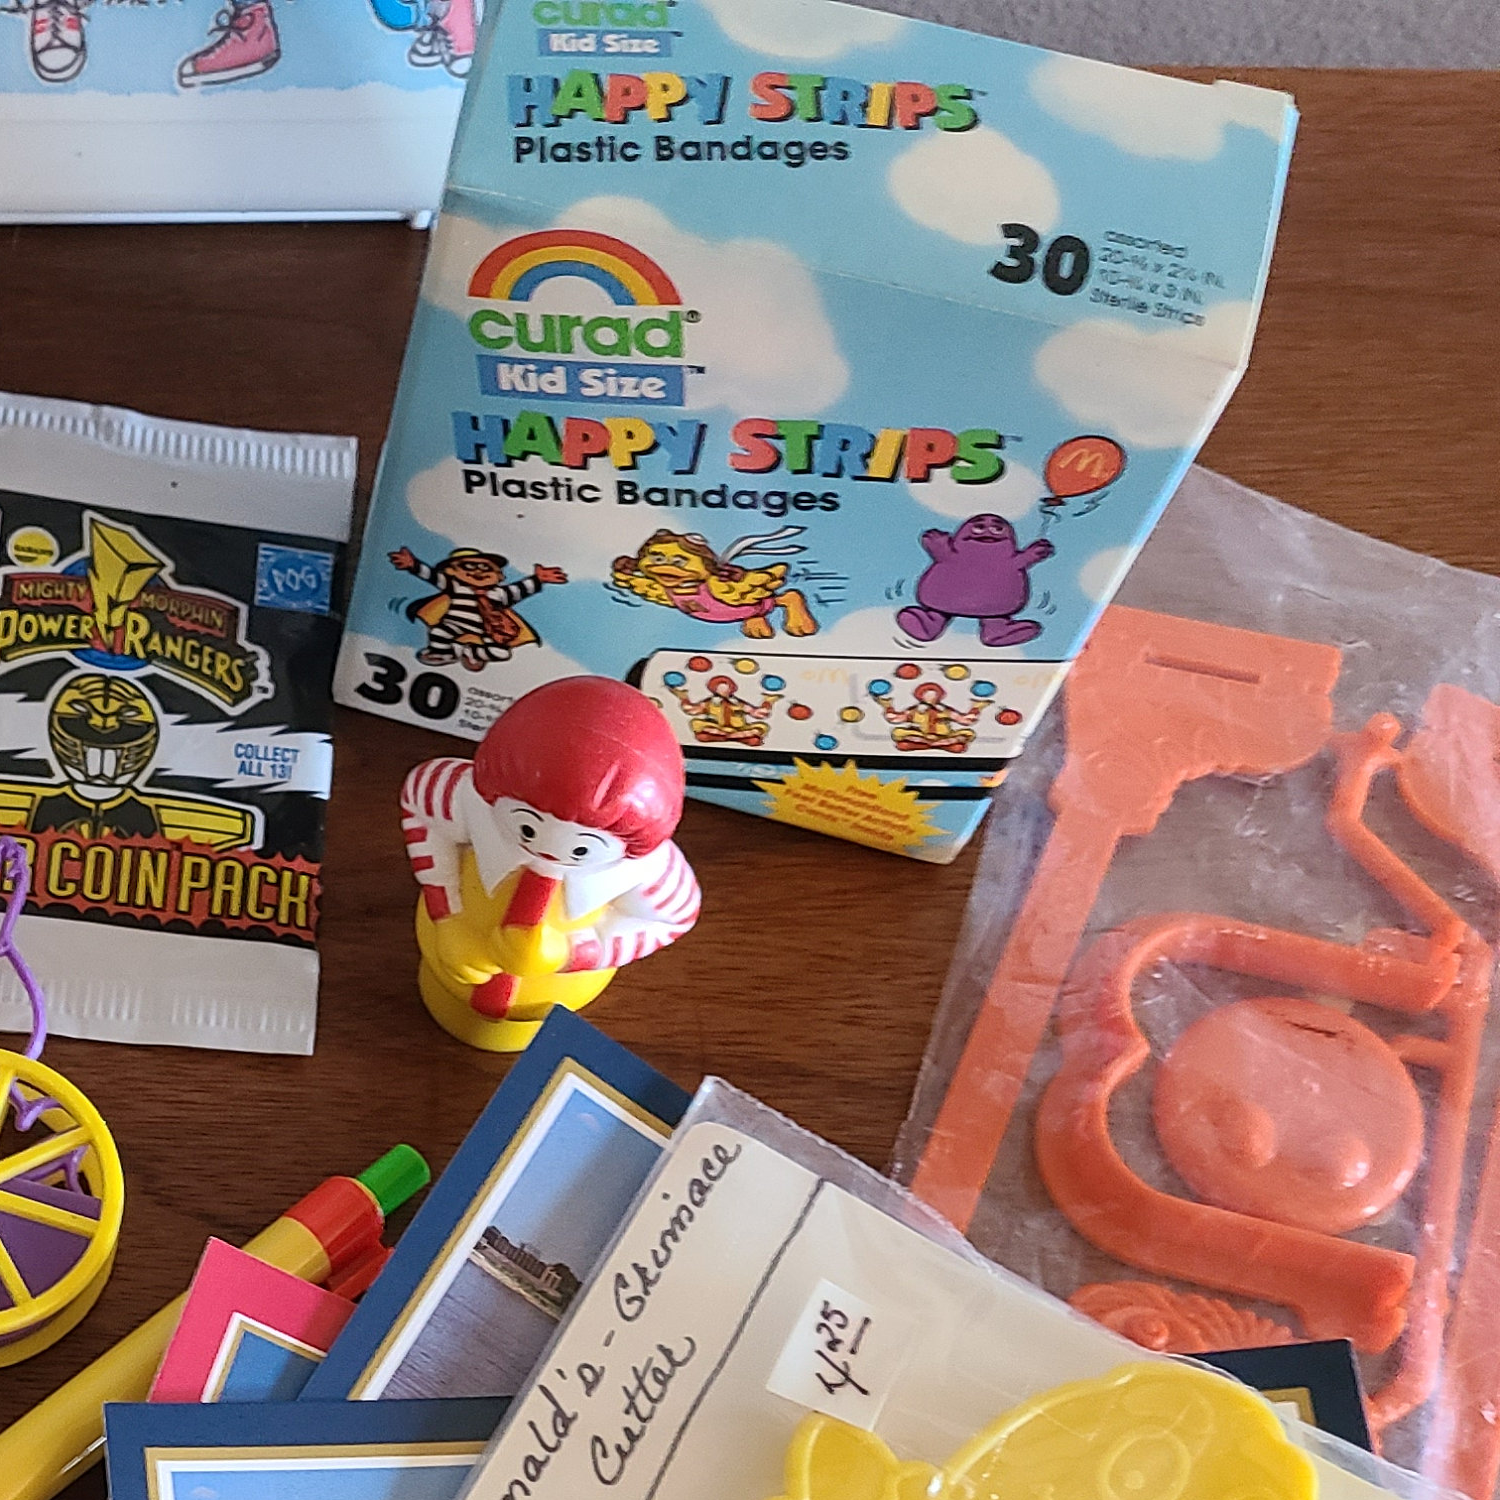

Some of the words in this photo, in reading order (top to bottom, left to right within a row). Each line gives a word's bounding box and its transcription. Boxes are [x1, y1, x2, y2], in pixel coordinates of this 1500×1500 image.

[548, 33, 597, 54] Kid
[603, 32, 661, 55] Size
[507, 69, 732, 127] HAPPY
[749, 71, 980, 133] STRIPS
[513, 134, 642, 165] Plastic
[654, 135, 851, 169] Bandages
[990, 221, 1092, 297] 30
[497, 361, 568, 398] Kid
[578, 366, 667, 401] Size
[451, 409, 705, 475] HAPPY
[728, 418, 1007, 484] STRIPS
[463, 468, 602, 505] Plastic
[616, 479, 841, 518] Bandages
[17, 580, 88, 603] MIGHTY
[139, 591, 225, 632] MORPHIN
[123, 616, 247, 695] RANGERS
[355, 651, 461, 720] 30
[234, 742, 301, 765] COLLECT
[236, 761, 265, 778] ALL
[47, 841, 170, 911] COIN
[176, 854, 312, 929] PACK
[589, 1335, 697, 1487] Cutter
